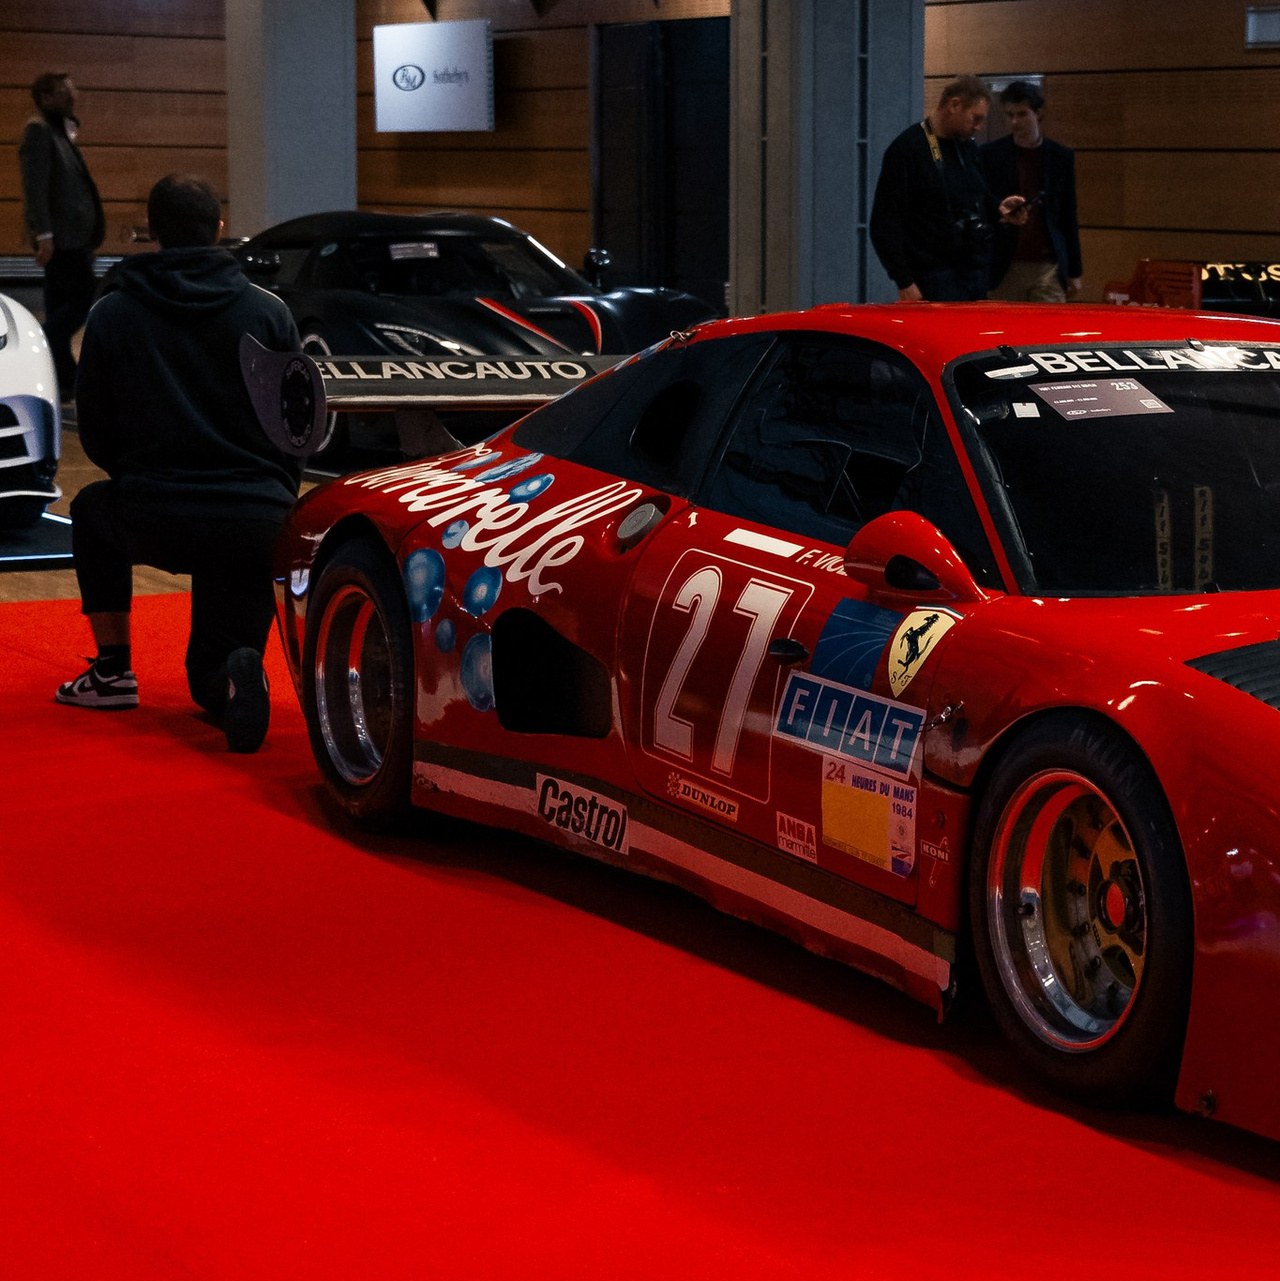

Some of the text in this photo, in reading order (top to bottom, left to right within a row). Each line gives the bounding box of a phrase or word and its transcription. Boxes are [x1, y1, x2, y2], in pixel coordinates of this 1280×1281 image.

[1110, 381, 1140, 391] 253
[795, 549, 824, 566] F.
[653, 565, 795, 779] 27
[786, 687, 914, 761] FIAT
[826, 761, 915, 803] 24 HEURES DU MANS
[538, 778, 627, 851] Castrol
[681, 784, 736, 816] DUNLOP
[891, 802, 914, 819] 1984
[922, 842, 949, 862] KONI
